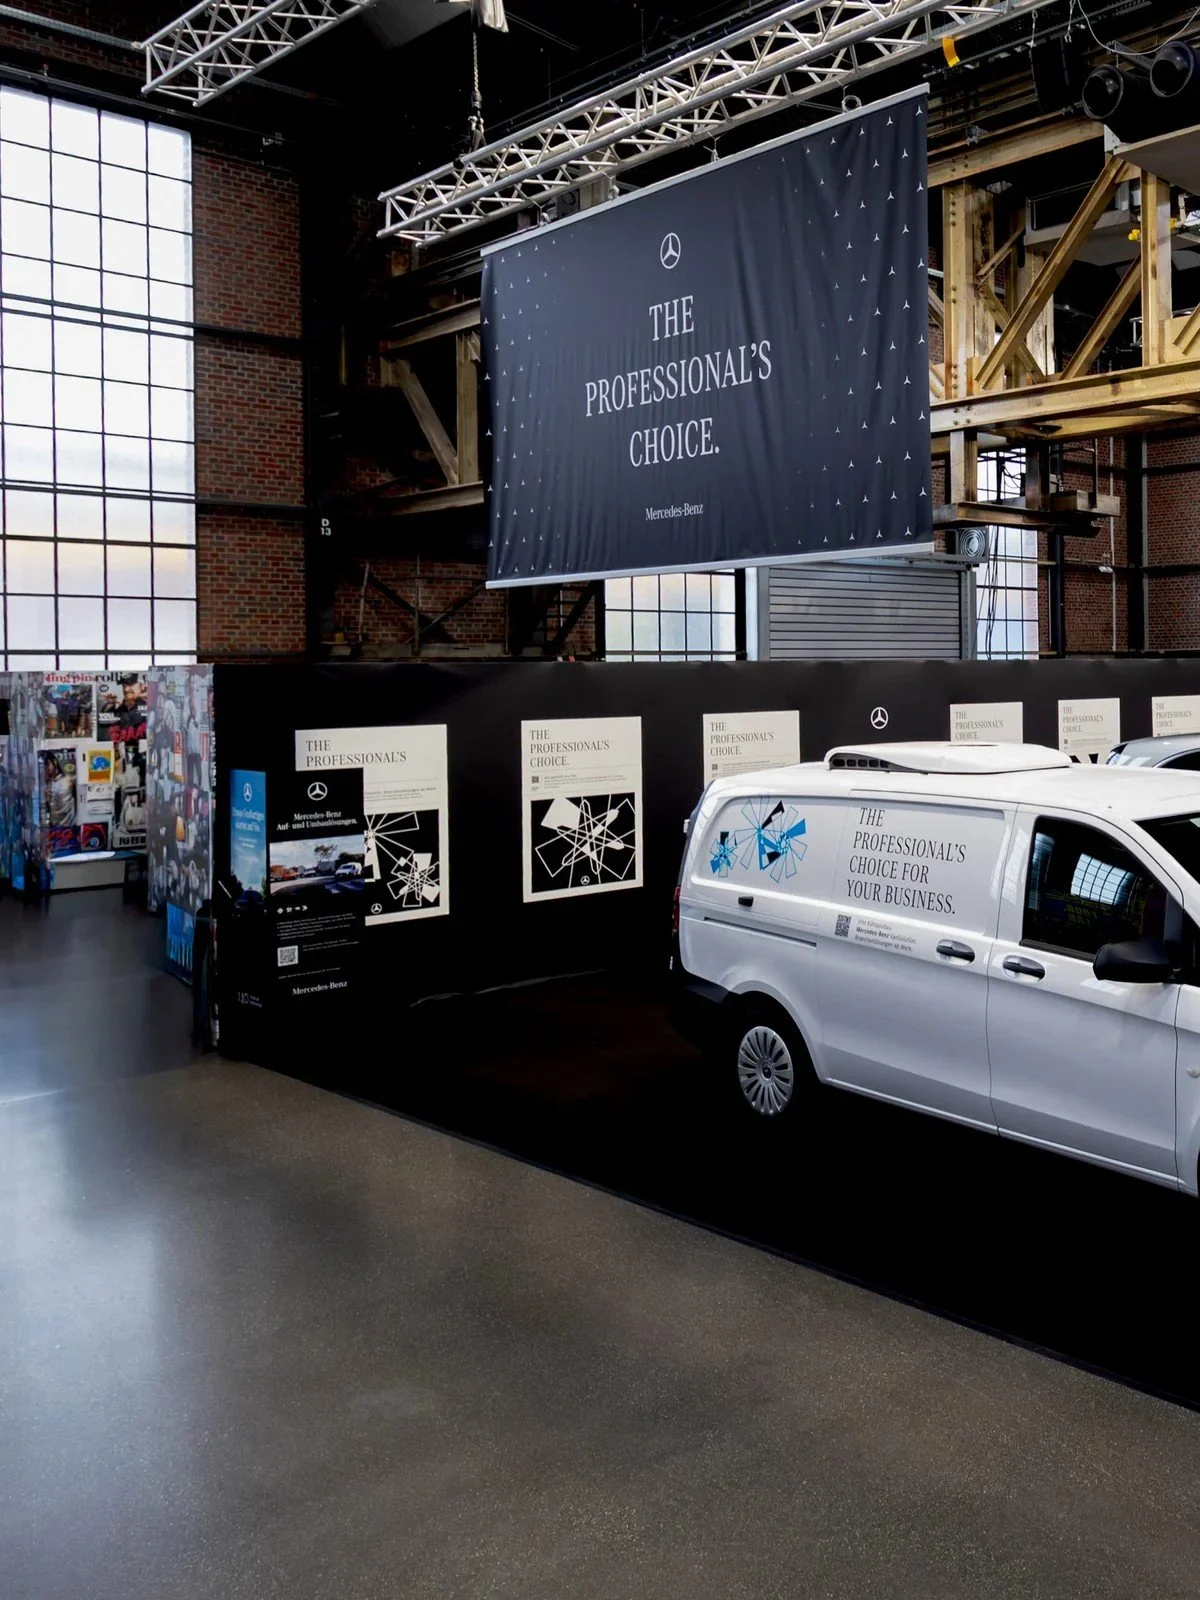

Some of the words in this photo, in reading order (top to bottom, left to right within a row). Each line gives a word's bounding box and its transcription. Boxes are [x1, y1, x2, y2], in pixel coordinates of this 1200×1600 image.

[649, 295, 694, 341] THE
[585, 340, 772, 417] PROFESSIONAL'S
[629, 417, 720, 467] CHOICE.
[645, 503, 704, 521] Mercedes-Benz
[321, 518, 330, 527] D
[320, 527, 332, 536] 13
[955, 711, 968, 720] THE
[710, 722, 727, 732] THE
[955, 720, 1004, 730] PROFESSIONAL'S
[529, 729, 550, 740] THE
[710, 732, 774, 744] PROFESSIONAL'S
[306, 739, 331, 752] THE
[529, 740, 610, 754] PROFESSIONAL'S
[710, 746, 742, 756] CHOICE.
[306, 751, 407, 767] PROFESSIONAL'S
[529, 756, 570, 768] CHOICE.
[293, 811, 341, 821] Mercedes-Benz
[859, 807, 885, 827] THE
[277, 823, 291, 831] Auf-
[306, 818, 358, 829] Umbaulösungen.
[852, 830, 967, 863] PROFESSIONAL'S
[849, 855, 899, 880] CHOICE
[901, 862, 929, 884] FOR
[847, 879, 881, 903] YOUR
[885, 885, 956, 915] BUSINESS.
[292, 981, 348, 995] Mercedes-Benz
